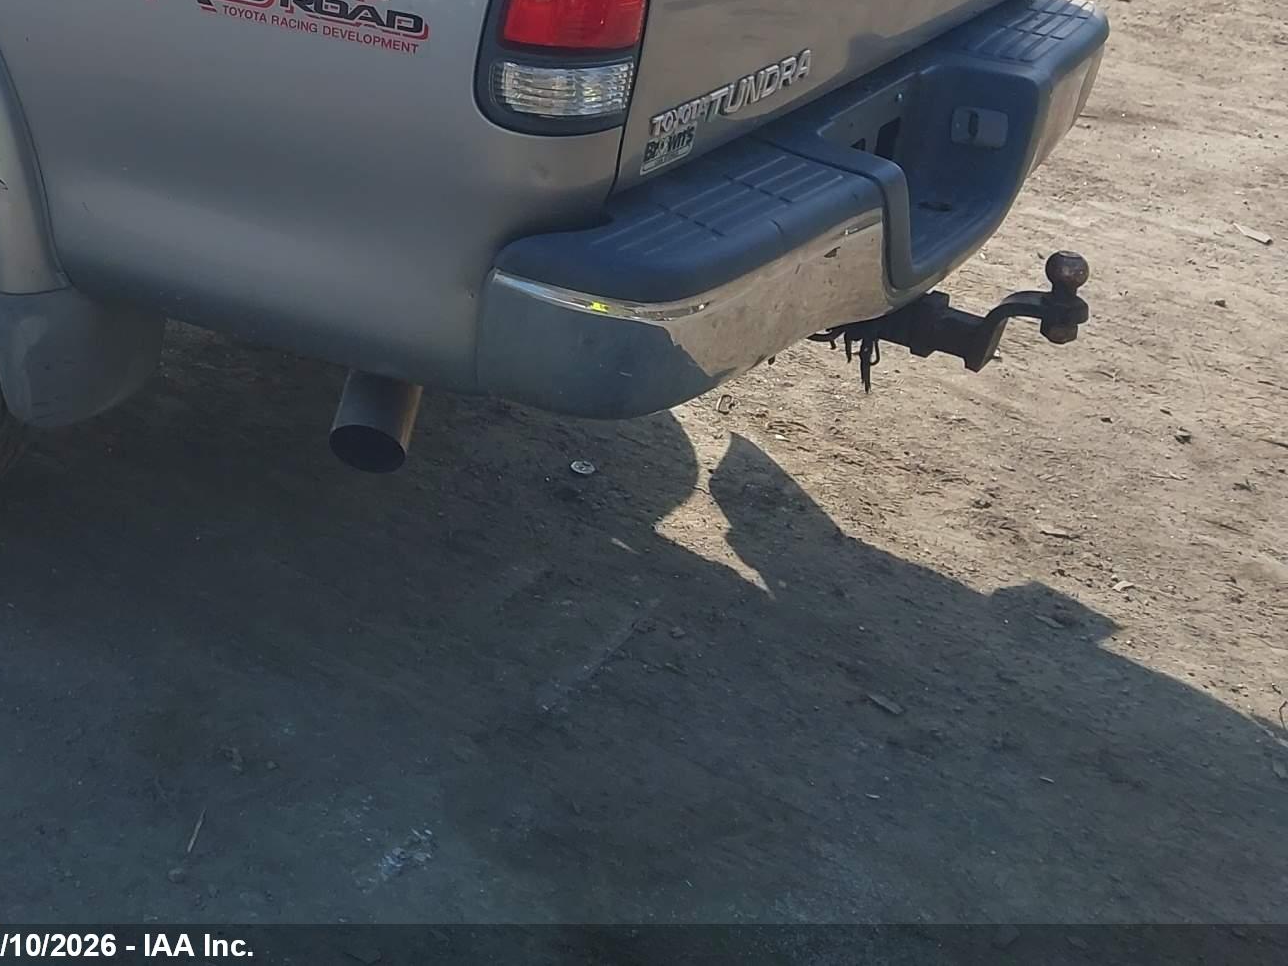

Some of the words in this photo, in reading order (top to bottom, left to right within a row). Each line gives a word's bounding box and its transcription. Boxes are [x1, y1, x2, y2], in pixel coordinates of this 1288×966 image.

[222, 4, 268, 24] TOYOTA
[271, 15, 319, 34] RACING
[322, 24, 419, 54] DEVELOPMENT
[649, 96, 711, 136] TOYOTA
[709, 48, 812, 116] TUNDRA
